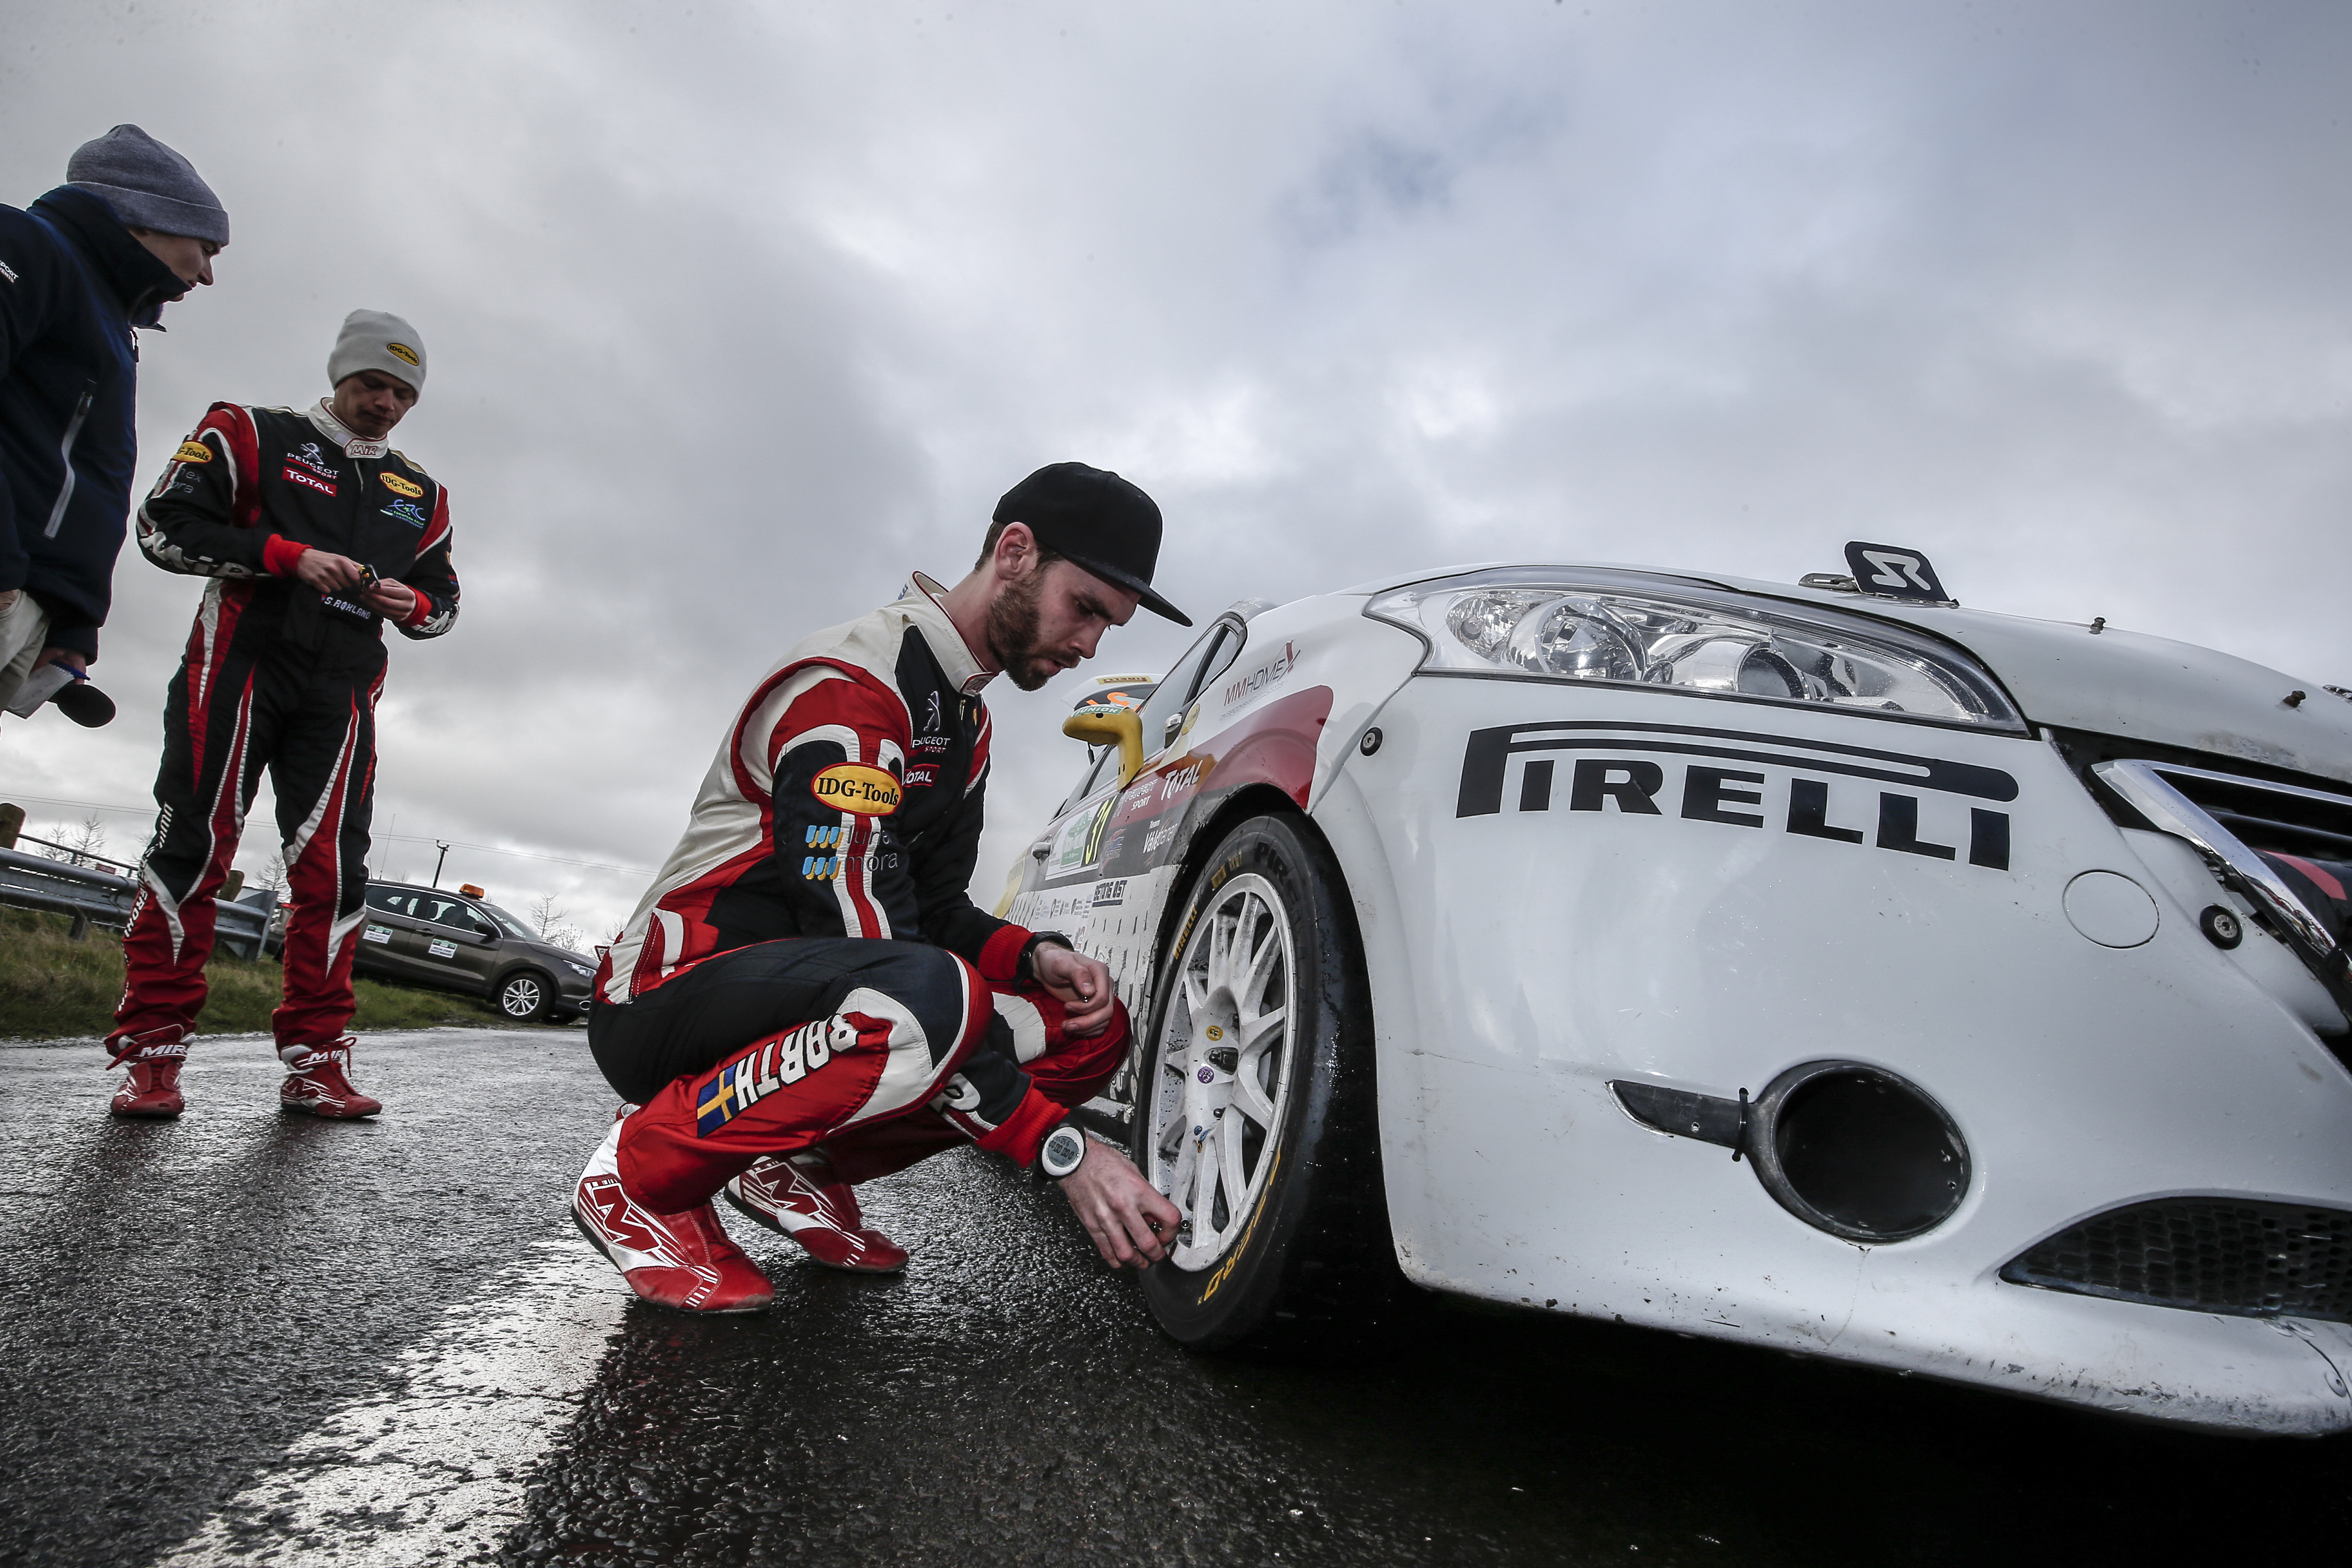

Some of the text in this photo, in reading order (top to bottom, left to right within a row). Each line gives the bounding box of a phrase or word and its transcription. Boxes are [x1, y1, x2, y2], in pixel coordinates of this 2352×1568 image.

[0, 260, 18, 280] PORT
[389, 345, 418, 364] IDG-Tools
[287, 453, 339, 475] PEUGEOT
[313, 468, 338, 479] SPORT
[286, 469, 334, 494] TOTAL
[381, 474, 422, 496] IDG-Tools
[1075, 706, 1119, 716] JUNIOR
[1161, 759, 1203, 801] TOTAL
[817, 777, 899, 806] IDG-Tools
[1456, 721, 2020, 872] PIRELLI
[1131, 795, 1151, 811] SPORT
[1173, 904, 1198, 960] PIRELLI
